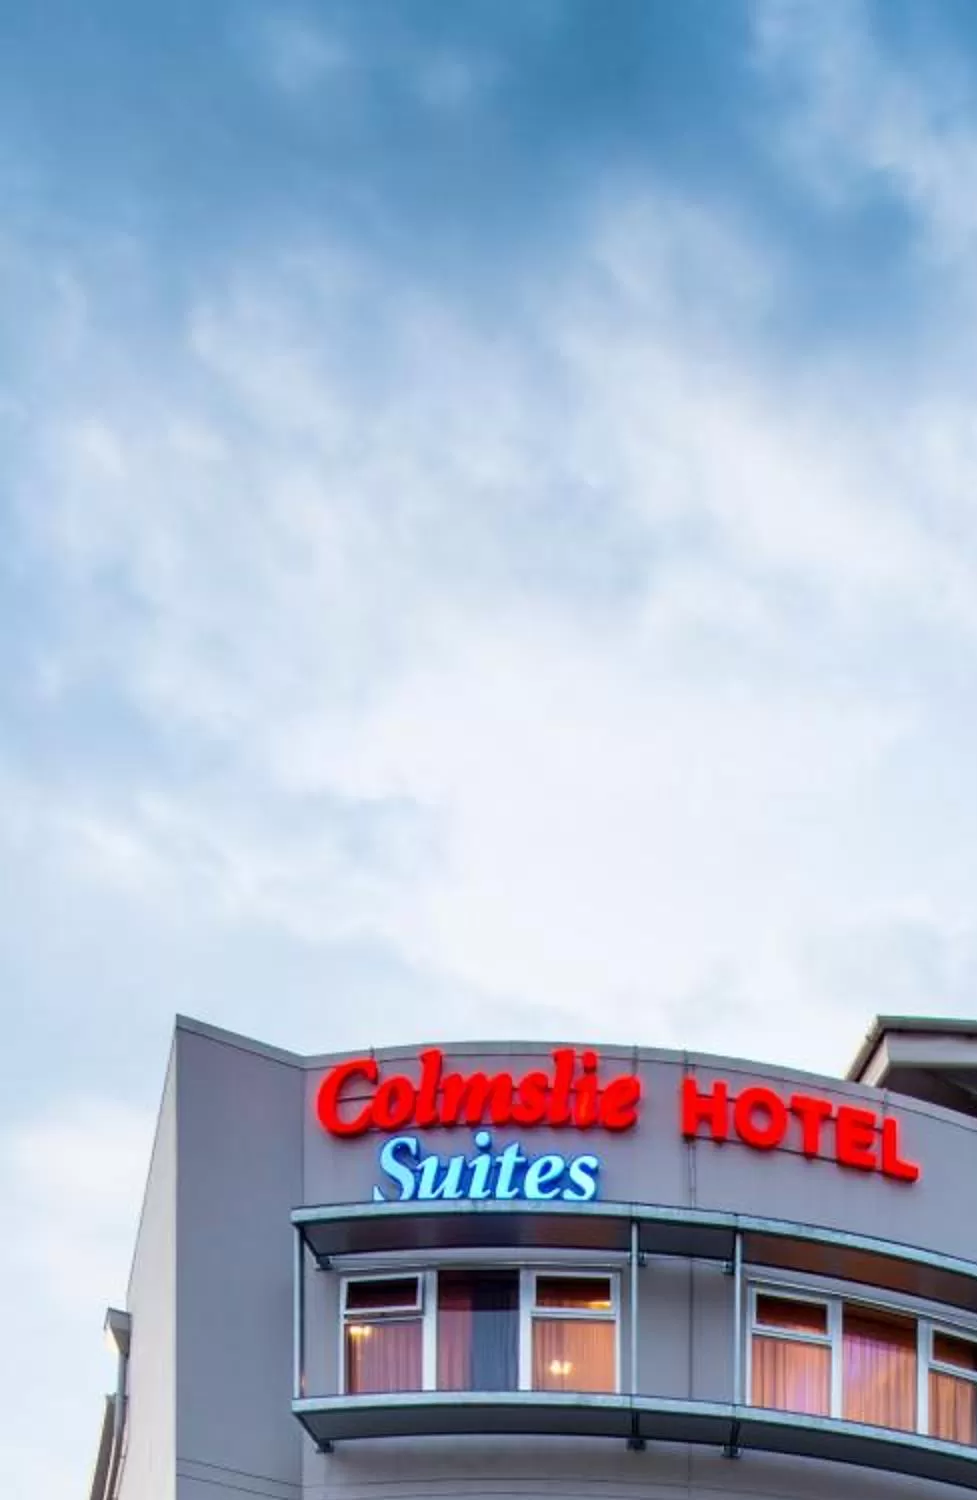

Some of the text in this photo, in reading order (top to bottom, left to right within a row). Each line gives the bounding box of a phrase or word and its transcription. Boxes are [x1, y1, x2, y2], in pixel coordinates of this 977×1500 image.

[317, 1048, 919, 1182] Colmslie HOTEL
[373, 1131, 599, 1201] Suites
